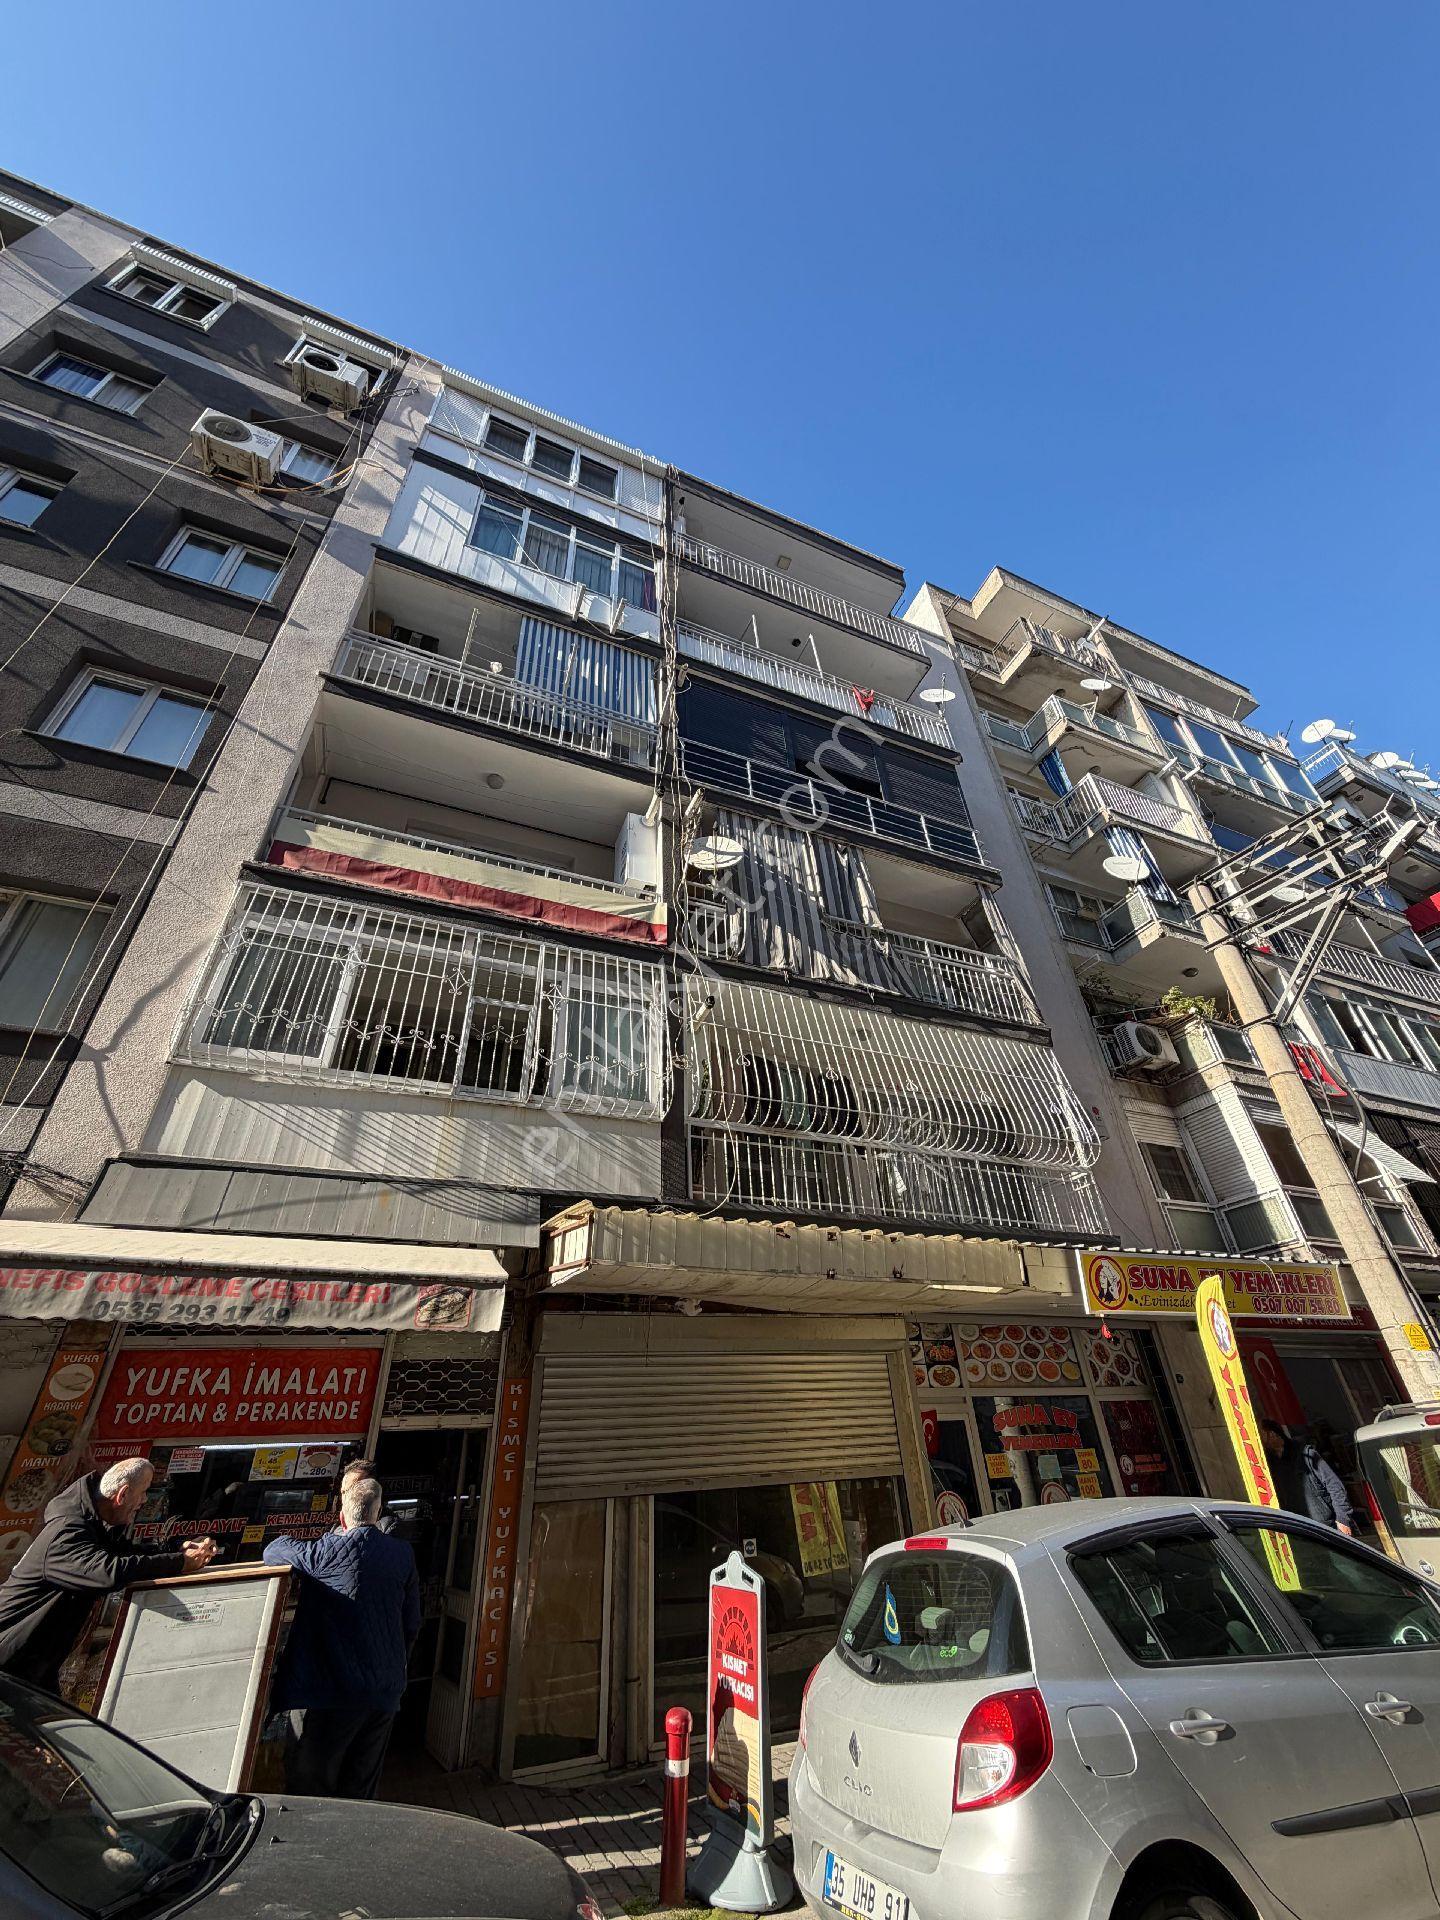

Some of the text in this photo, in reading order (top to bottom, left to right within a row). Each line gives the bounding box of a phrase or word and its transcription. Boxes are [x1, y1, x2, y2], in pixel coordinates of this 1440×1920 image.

[1128, 1264, 1197, 1292] SUNA
[1228, 1268, 1338, 1296] YEMEKLERİ
[1140, 1294, 1196, 1309] Evinizdek
[1251, 1296, 1283, 1314] 0507
[1285, 1296, 1307, 1314] 007
[1326, 1298, 1341, 1316] 80
[92, 1301, 291, 1326] 0535 293 17 49
[63, 1354, 100, 1363] YUFKA
[126, 1361, 367, 1396] YUFKA İMALATI
[44, 1402, 84, 1411] KADAYIF
[114, 1401, 361, 1425] TOPTAN & PERAKENDE
[992, 1404, 1078, 1432] SUNA EV
[502, 1384, 523, 1481] KISMET
[21, 1457, 61, 1467] MANTI
[309, 1468, 327, 1476] 280
[1081, 1459, 1093, 1469] 80
[1080, 1484, 1096, 1495] 100
[171, 1517, 249, 1536] KADAYIF
[485, 1507, 512, 1688] YUFKACISI
[722, 1653, 748, 1677] KISMET
[717, 1672, 754, 1702] YUFKACISI
[843, 1775, 873, 1797] CLIO
[831, 1862, 845, 1898] 35
[853, 1873, 876, 1914] UHB
[884, 1892, 901, 1920] 91
